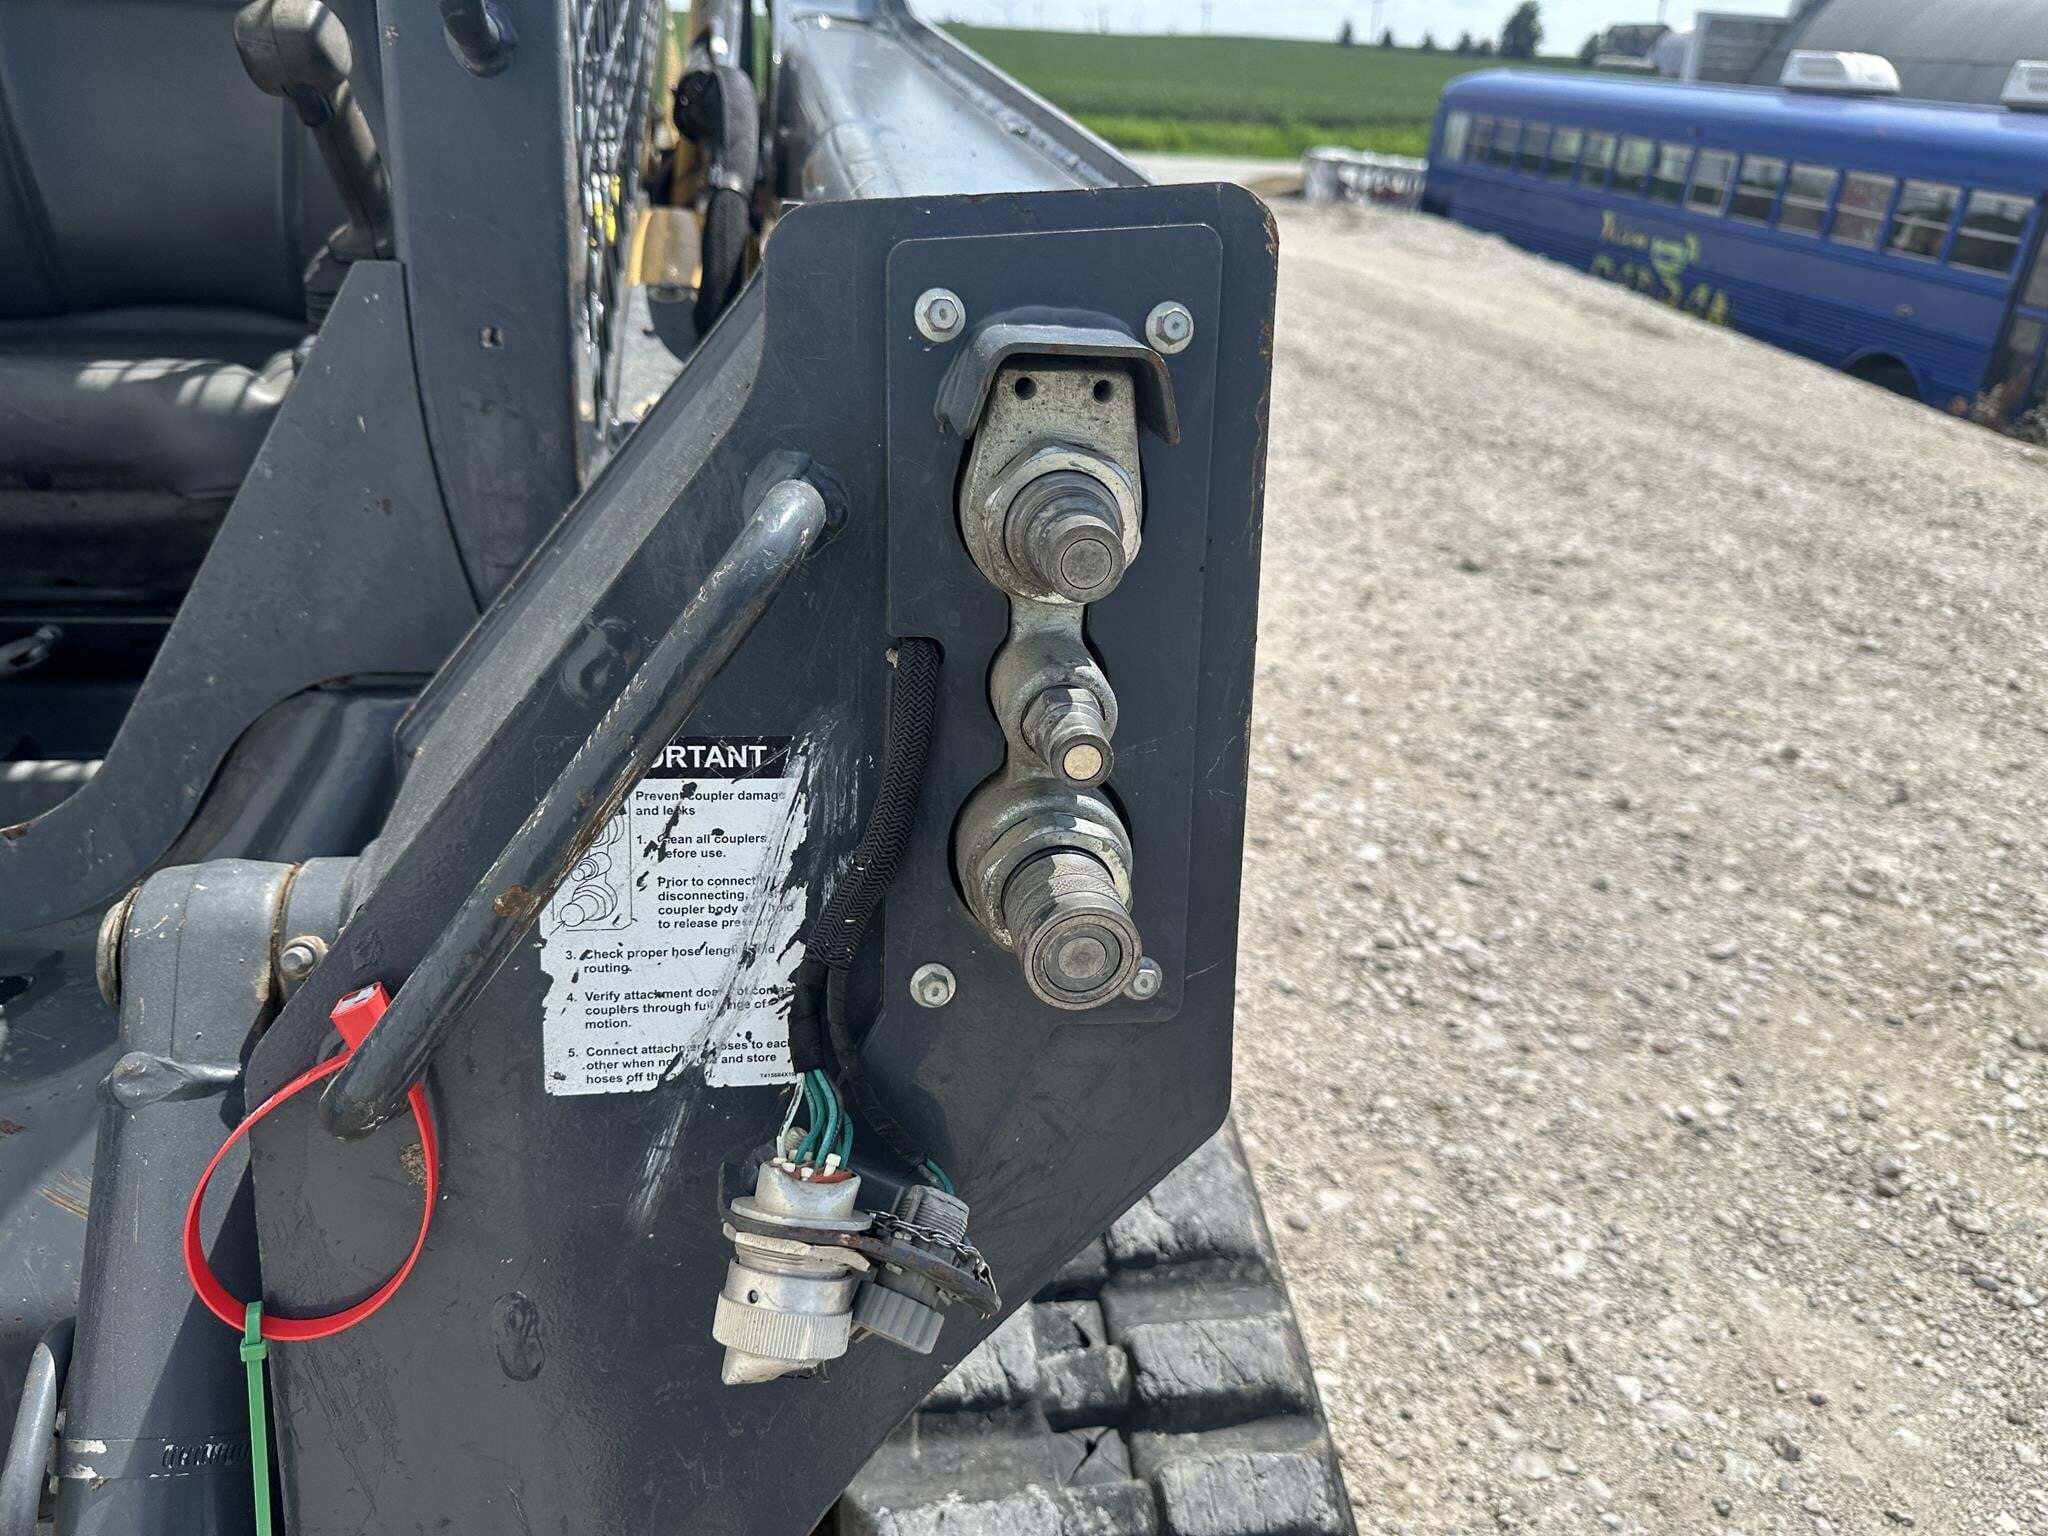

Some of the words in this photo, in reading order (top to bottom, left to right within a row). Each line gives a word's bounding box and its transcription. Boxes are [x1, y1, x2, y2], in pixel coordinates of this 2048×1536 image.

[635, 806, 659, 816] and
[663, 805, 696, 816] leks
[636, 834, 647, 845] 1.
[696, 833, 710, 844] all
[714, 833, 767, 847] couplers
[666, 848, 697, 859] efore
[701, 850, 726, 858] use.
[657, 876, 689, 888] Prior
[692, 877, 704, 887] to
[707, 876, 758, 887] connect
[658, 904, 705, 917] coupler
[708, 903, 739, 916] body
[658, 919, 671, 930] to
[674, 919, 718, 929] release
[565, 950, 577, 960] 3.
[627, 949, 669, 961] proper
[671, 947, 701, 959] hose
[584, 962, 632, 975] routing.
[566, 992, 578, 1002] 4.
[584, 991, 620, 1003] Verify
[585, 1004, 639, 1017] couplers
[643, 1002, 691, 1015] through
[754, 998, 767, 1009] of
[584, 1019, 632, 1030] motion.
[568, 1047, 579, 1058] 5.
[585, 1046, 638, 1057] Connect
[720, 1041, 748, 1051] oses
[751, 1040, 763, 1049] to
[766, 1040, 788, 1049] eac
[586, 1060, 619, 1071] other
[622, 1058, 655, 1069] when
[658, 1058, 673, 1068] no
[721, 1053, 743, 1064] and
[747, 1053, 777, 1063] store
[586, 1074, 623, 1085] hoses
[627, 1072, 643, 1083] off
[646, 1071, 659, 1081] th
